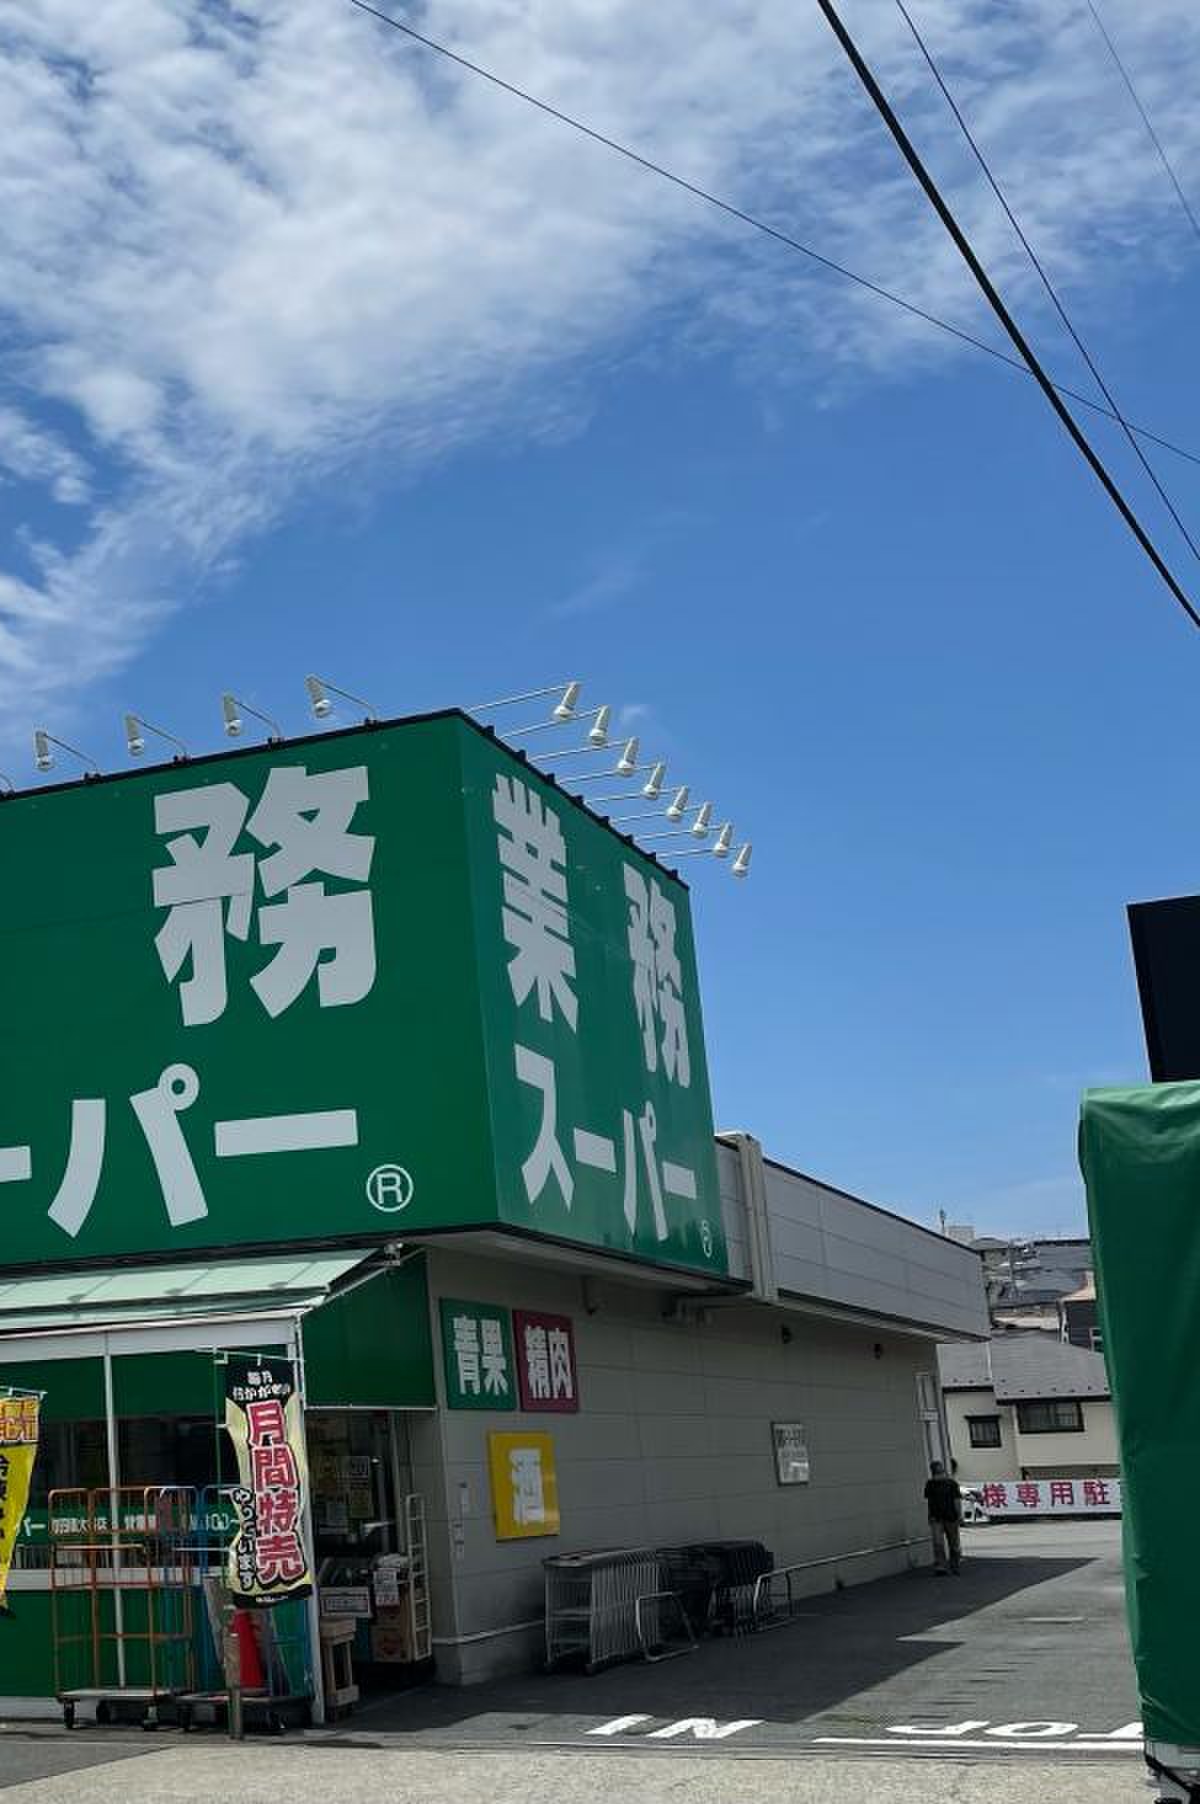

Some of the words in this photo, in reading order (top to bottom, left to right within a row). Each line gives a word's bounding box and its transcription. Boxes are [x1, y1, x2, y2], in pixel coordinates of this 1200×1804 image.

[493, 773, 690, 1088] 業務
[514, 1043, 697, 1242] スーパー
[453, 1316, 509, 1396] 青果
[525, 1326, 573, 1399] 精肉
[232, 1488, 256, 1588] やっています
[246, 1399, 304, 1584] 月間特売
